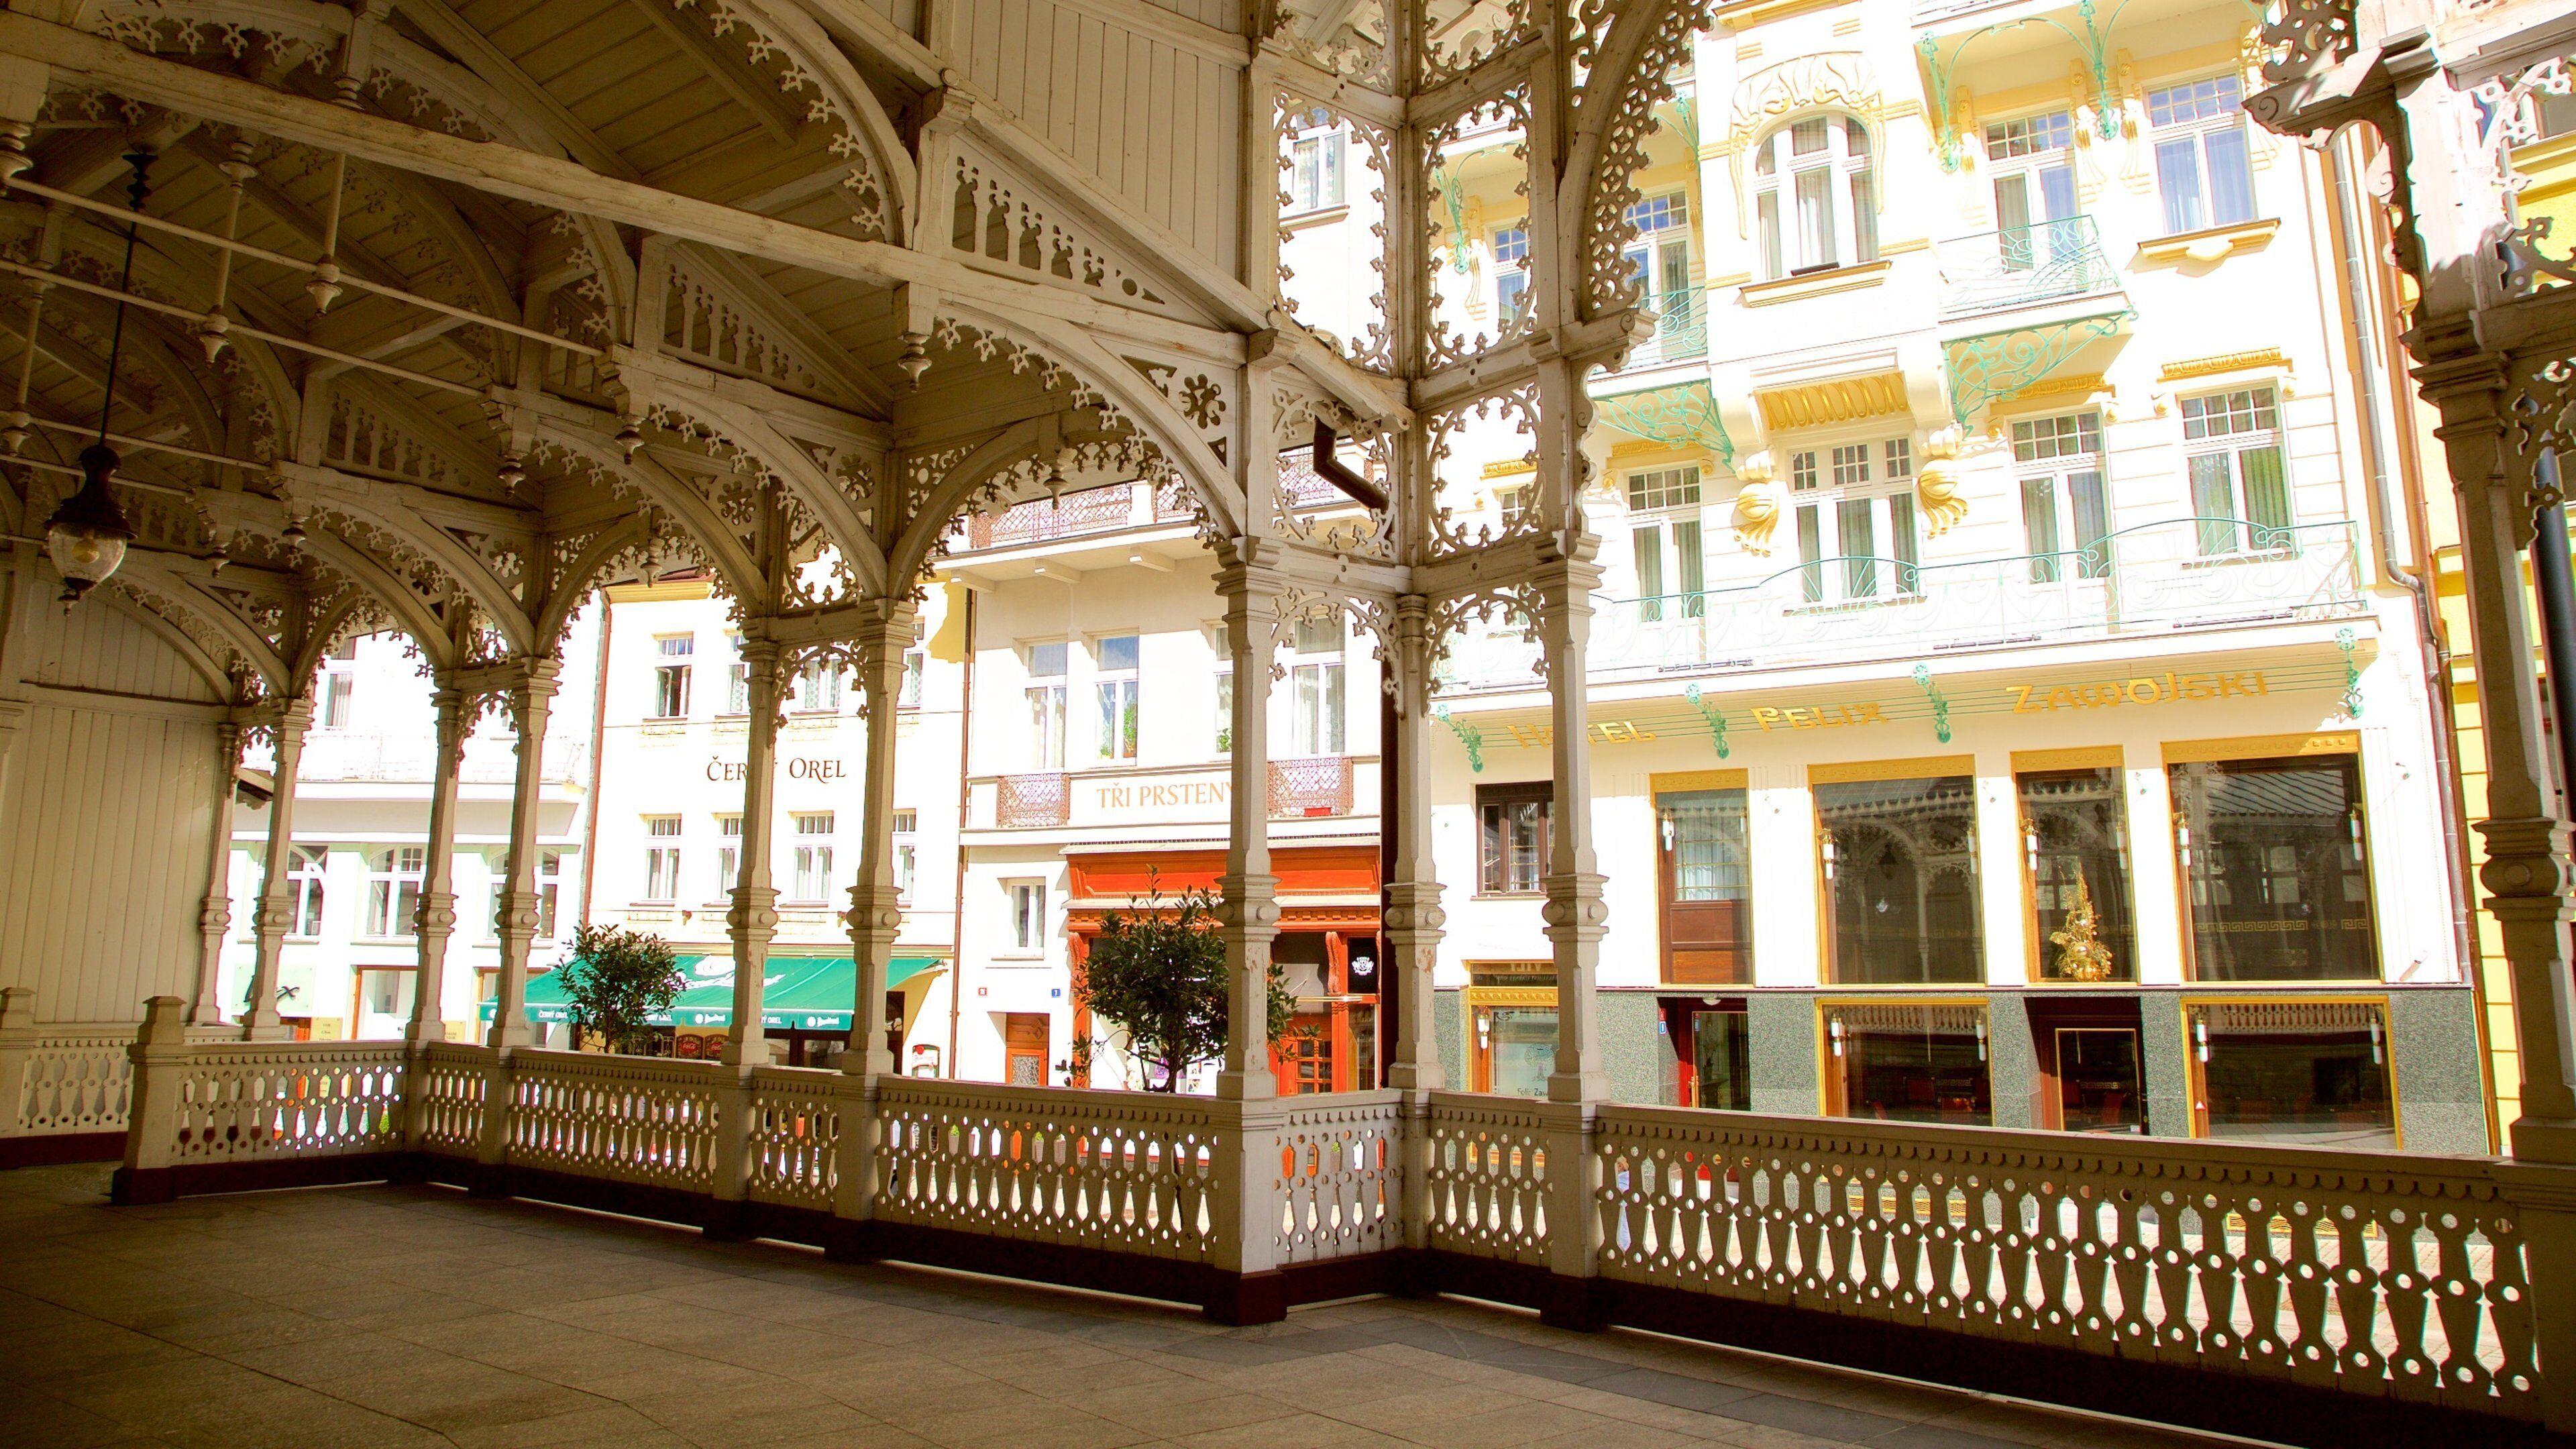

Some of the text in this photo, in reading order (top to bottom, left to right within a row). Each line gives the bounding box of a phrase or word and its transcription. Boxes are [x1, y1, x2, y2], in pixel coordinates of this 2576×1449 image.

[2006, 672, 2269, 713] ZAWOJSKI
[789, 757, 847, 784] OREL
[1096, 782, 1130, 808] TŘI
